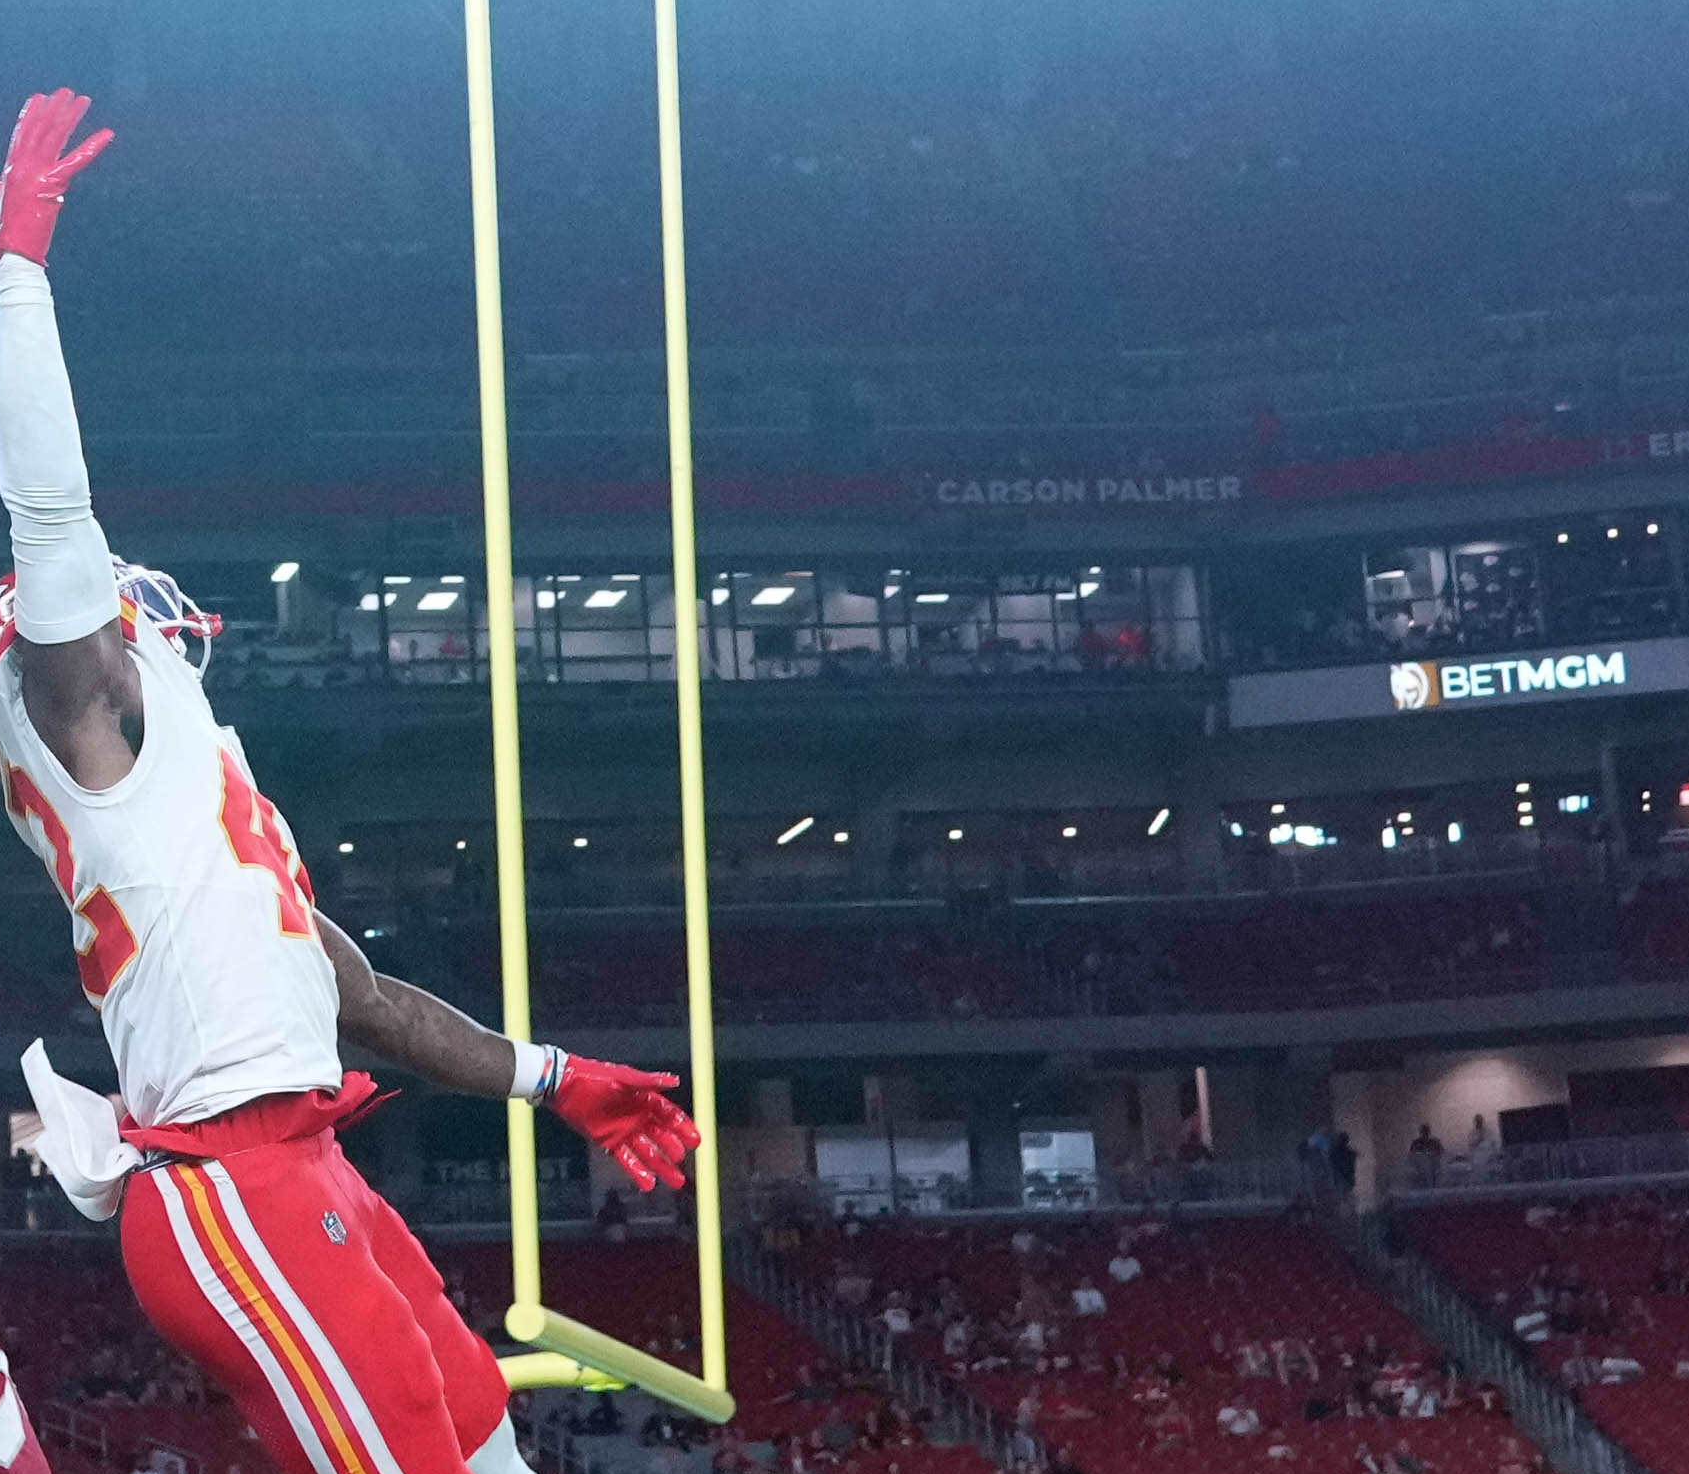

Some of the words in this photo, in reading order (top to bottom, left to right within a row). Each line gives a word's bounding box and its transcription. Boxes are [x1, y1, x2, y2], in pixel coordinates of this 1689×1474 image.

[936, 479, 1085, 504] CARSON
[1098, 475, 1242, 502] PALMER
[1440, 651, 1625, 701] BETMGM
